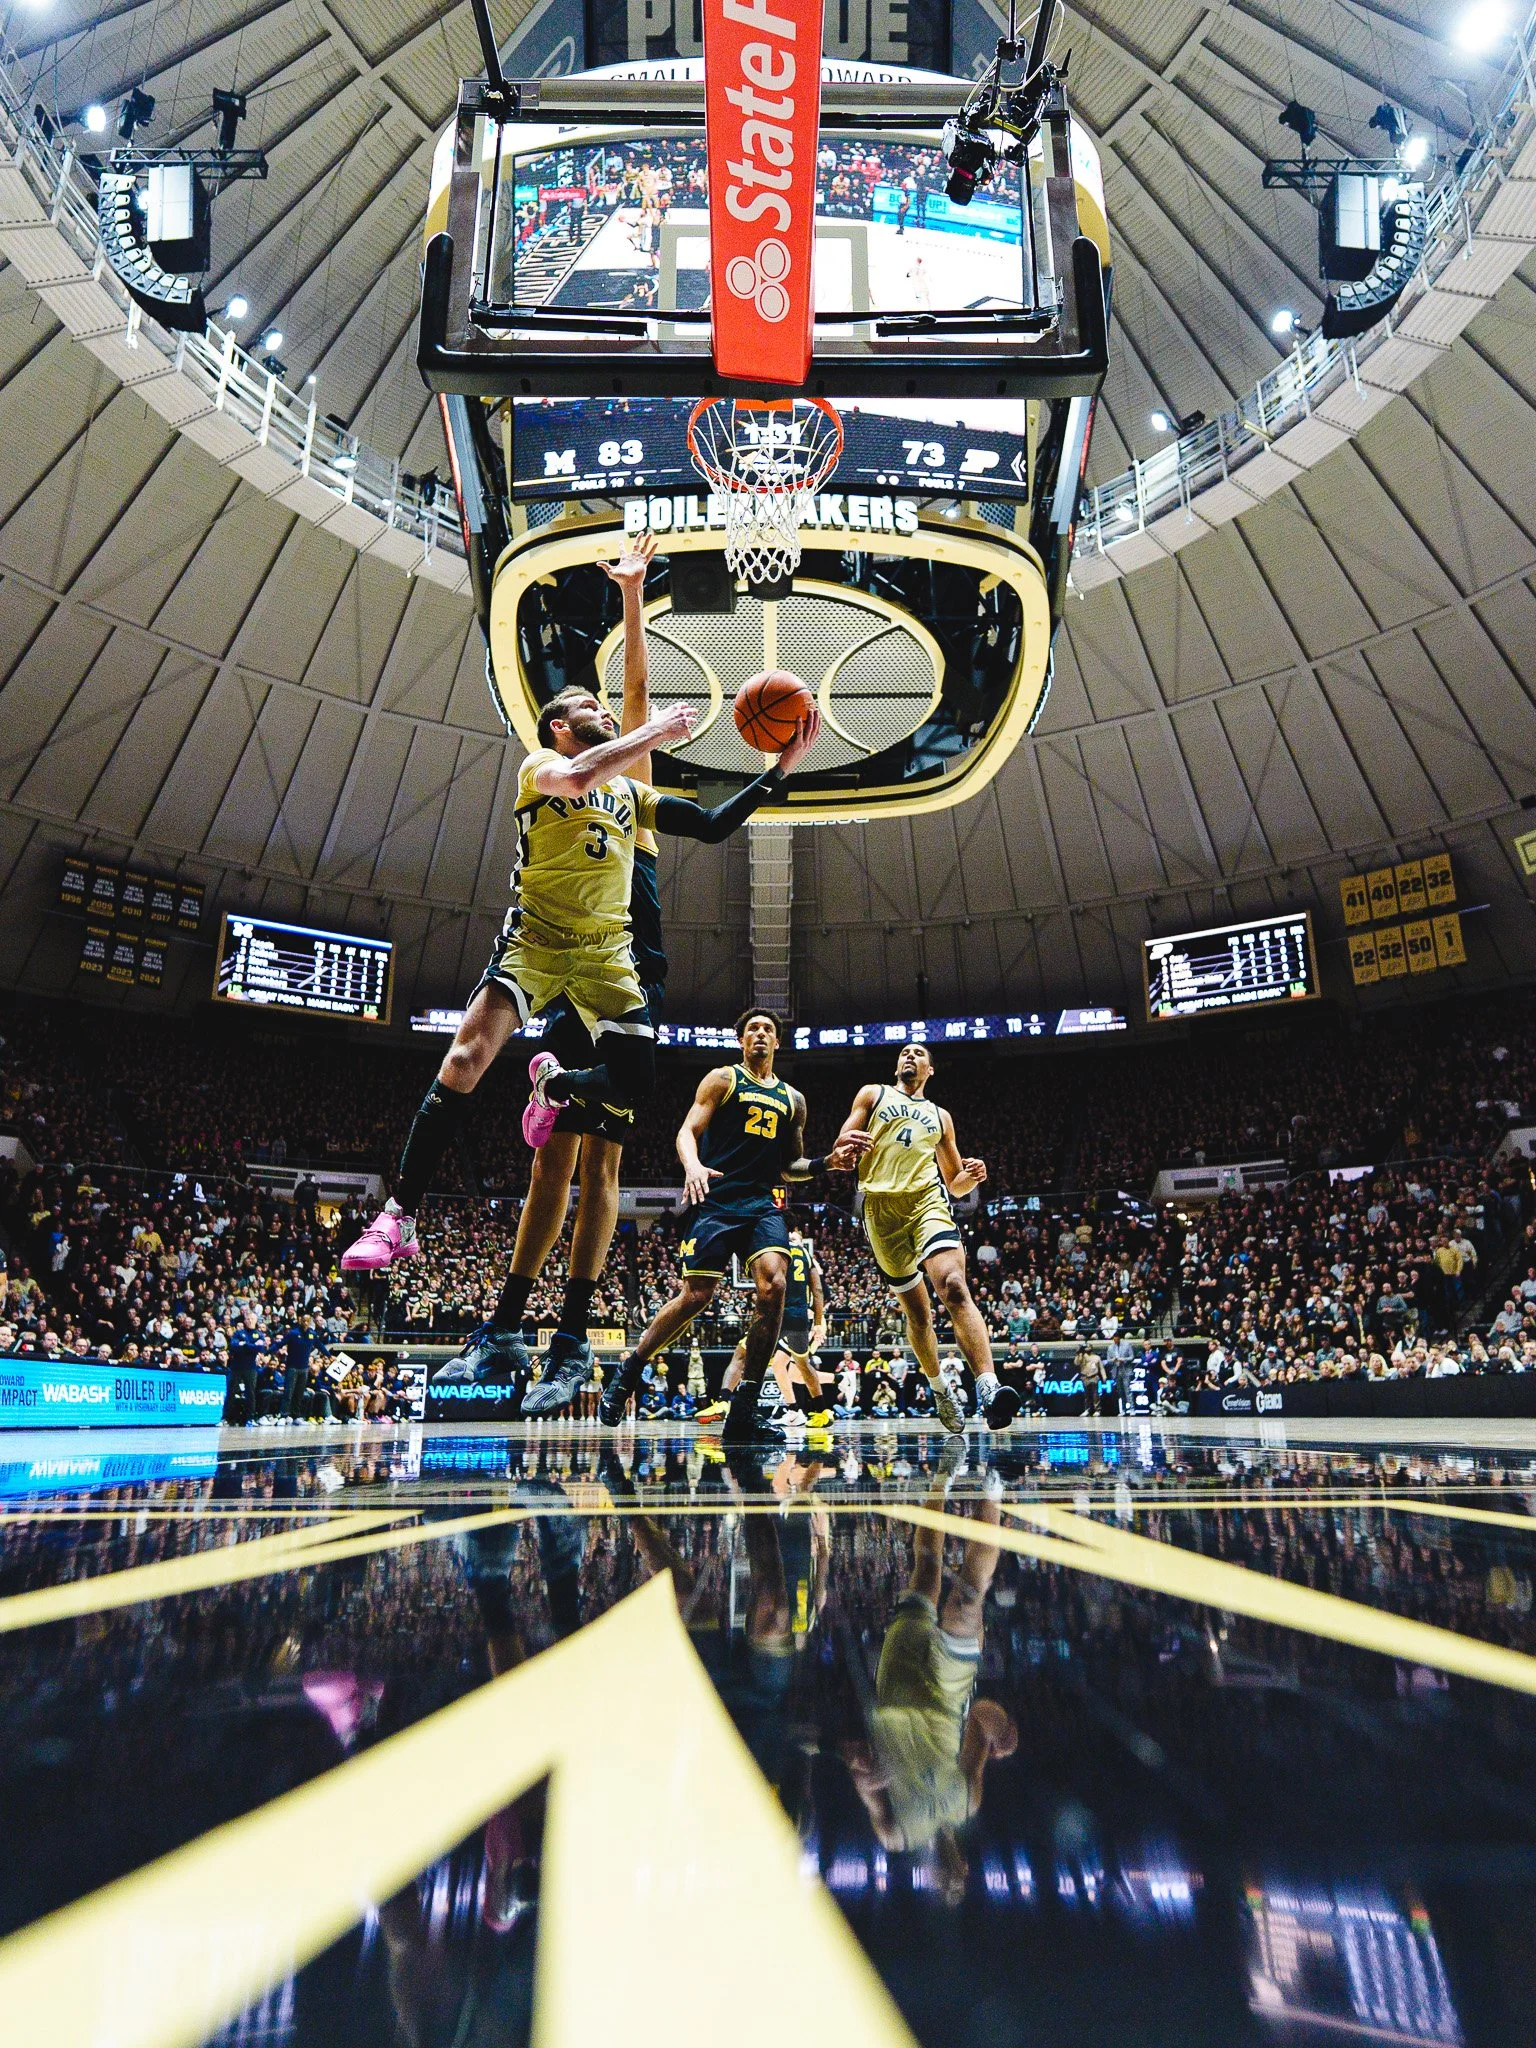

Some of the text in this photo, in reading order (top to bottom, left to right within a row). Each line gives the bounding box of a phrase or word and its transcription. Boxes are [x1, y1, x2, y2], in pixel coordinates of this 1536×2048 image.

[628, 0, 909, 62] PUUE
[598, 439, 644, 467] 83
[901, 440, 946, 468] 73
[623, 494, 919, 534] BOILERMAKERS
[547, 788, 633, 839] PURDUE
[584, 821, 609, 861] 3
[1399, 877, 1422, 895] 22
[1427, 869, 1451, 888] 32
[1346, 891, 1365, 907] 41
[1372, 884, 1394, 901] 40
[1408, 936, 1431, 954] 50
[1445, 931, 1454, 946] 1
[1353, 949, 1376, 967] 22
[1380, 942, 1403, 959] 32
[677, 1028, 691, 1042] FT
[945, 1022, 967, 1037] AST
[1006, 1018, 1022, 1033] TO
[744, 1105, 778, 1139] 23
[878, 1104, 938, 1134] PURDUE
[895, 1127, 913, 1148] 4
[680, 1238, 697, 1257] M
[793, 1259, 806, 1281] 2
[42, 1383, 111, 1403] WABASH
[115, 1379, 176, 1401] BOILER UP!
[429, 1385, 511, 1399] WABASH
[1036, 1380, 1113, 1394] WABAH
[179, 1389, 225, 1405] WABASH
